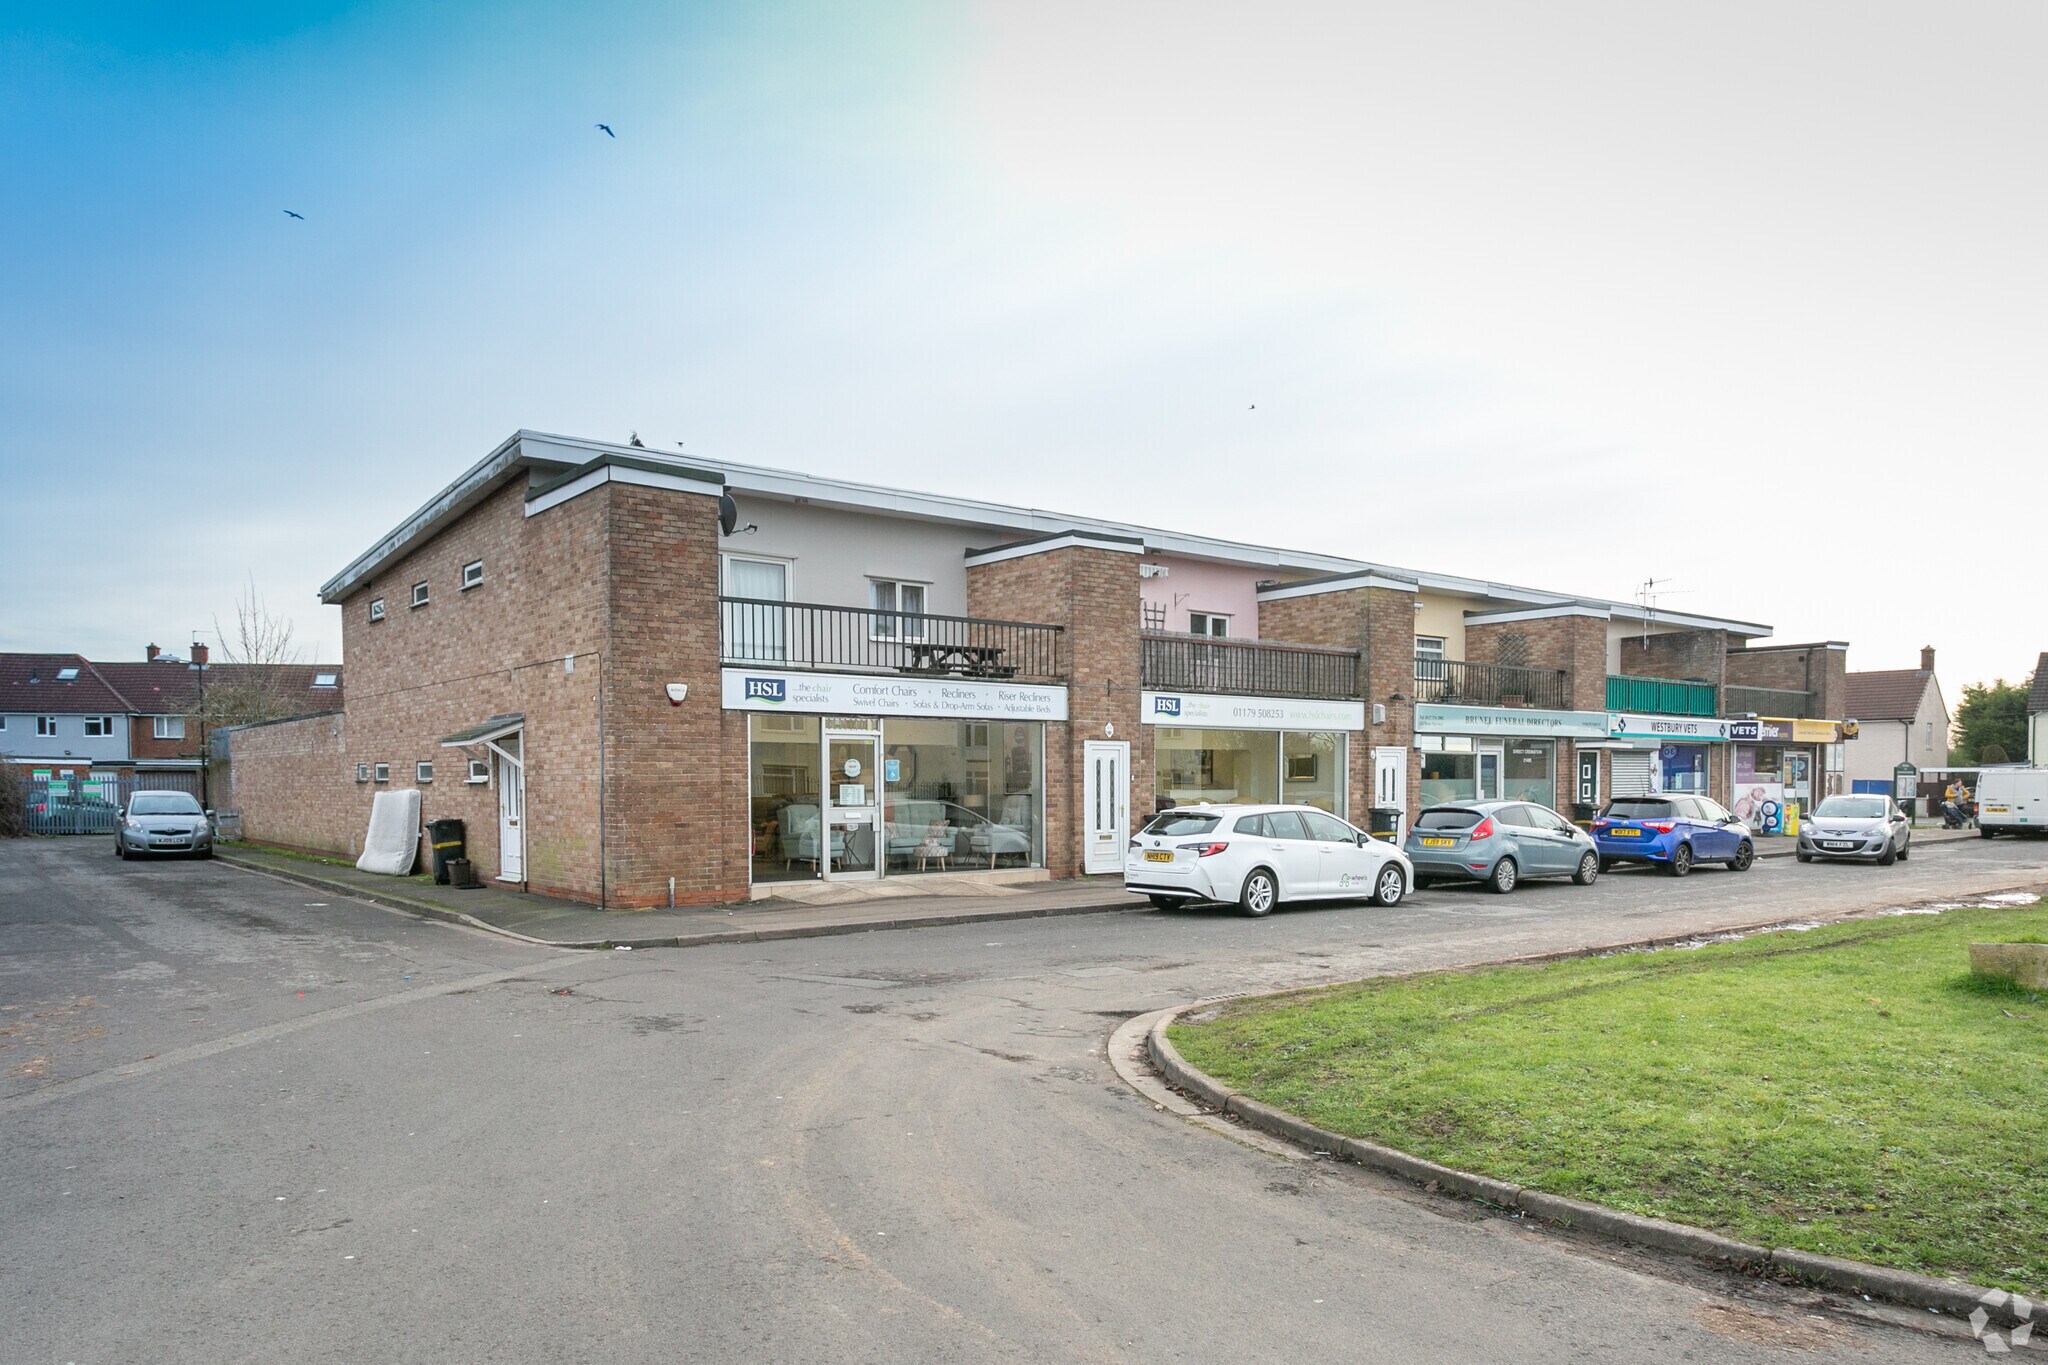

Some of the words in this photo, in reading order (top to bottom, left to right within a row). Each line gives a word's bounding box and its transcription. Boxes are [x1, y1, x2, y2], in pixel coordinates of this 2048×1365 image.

[748, 681, 782, 697] HSL
[812, 683, 832, 693] chair
[852, 683, 889, 696] Comfort
[891, 685, 917, 697] Chairs
[941, 687, 976, 699] Recliners
[998, 690, 1017, 701] Riser
[1019, 692, 1051, 703] Recliners
[792, 693, 829, 704] specialists
[1156, 698, 1179, 712] HSL
[853, 697, 876, 707] Swivel
[878, 698, 900, 708] Chairs
[913, 699, 931, 709] Sofas
[933, 701, 939, 709] &
[941, 701, 975, 711] Drop-Arm
[977, 702, 994, 711] Sofas
[1003, 703, 1034, 713] Adjustable
[1036, 704, 1051, 714] Beds
[1233, 706, 1256, 718] 01179
[1257, 708, 1284, 719] 508253
[1465, 715, 1492, 725] BRUNEL
[1495, 716, 1525, 726] FUNERAL
[1526, 717, 1562, 728] DIRECTORS
[1650, 721, 1683, 733] WESTBURY
[1684, 723, 1698, 734] VETS
[1731, 726, 1757, 735] VETS
